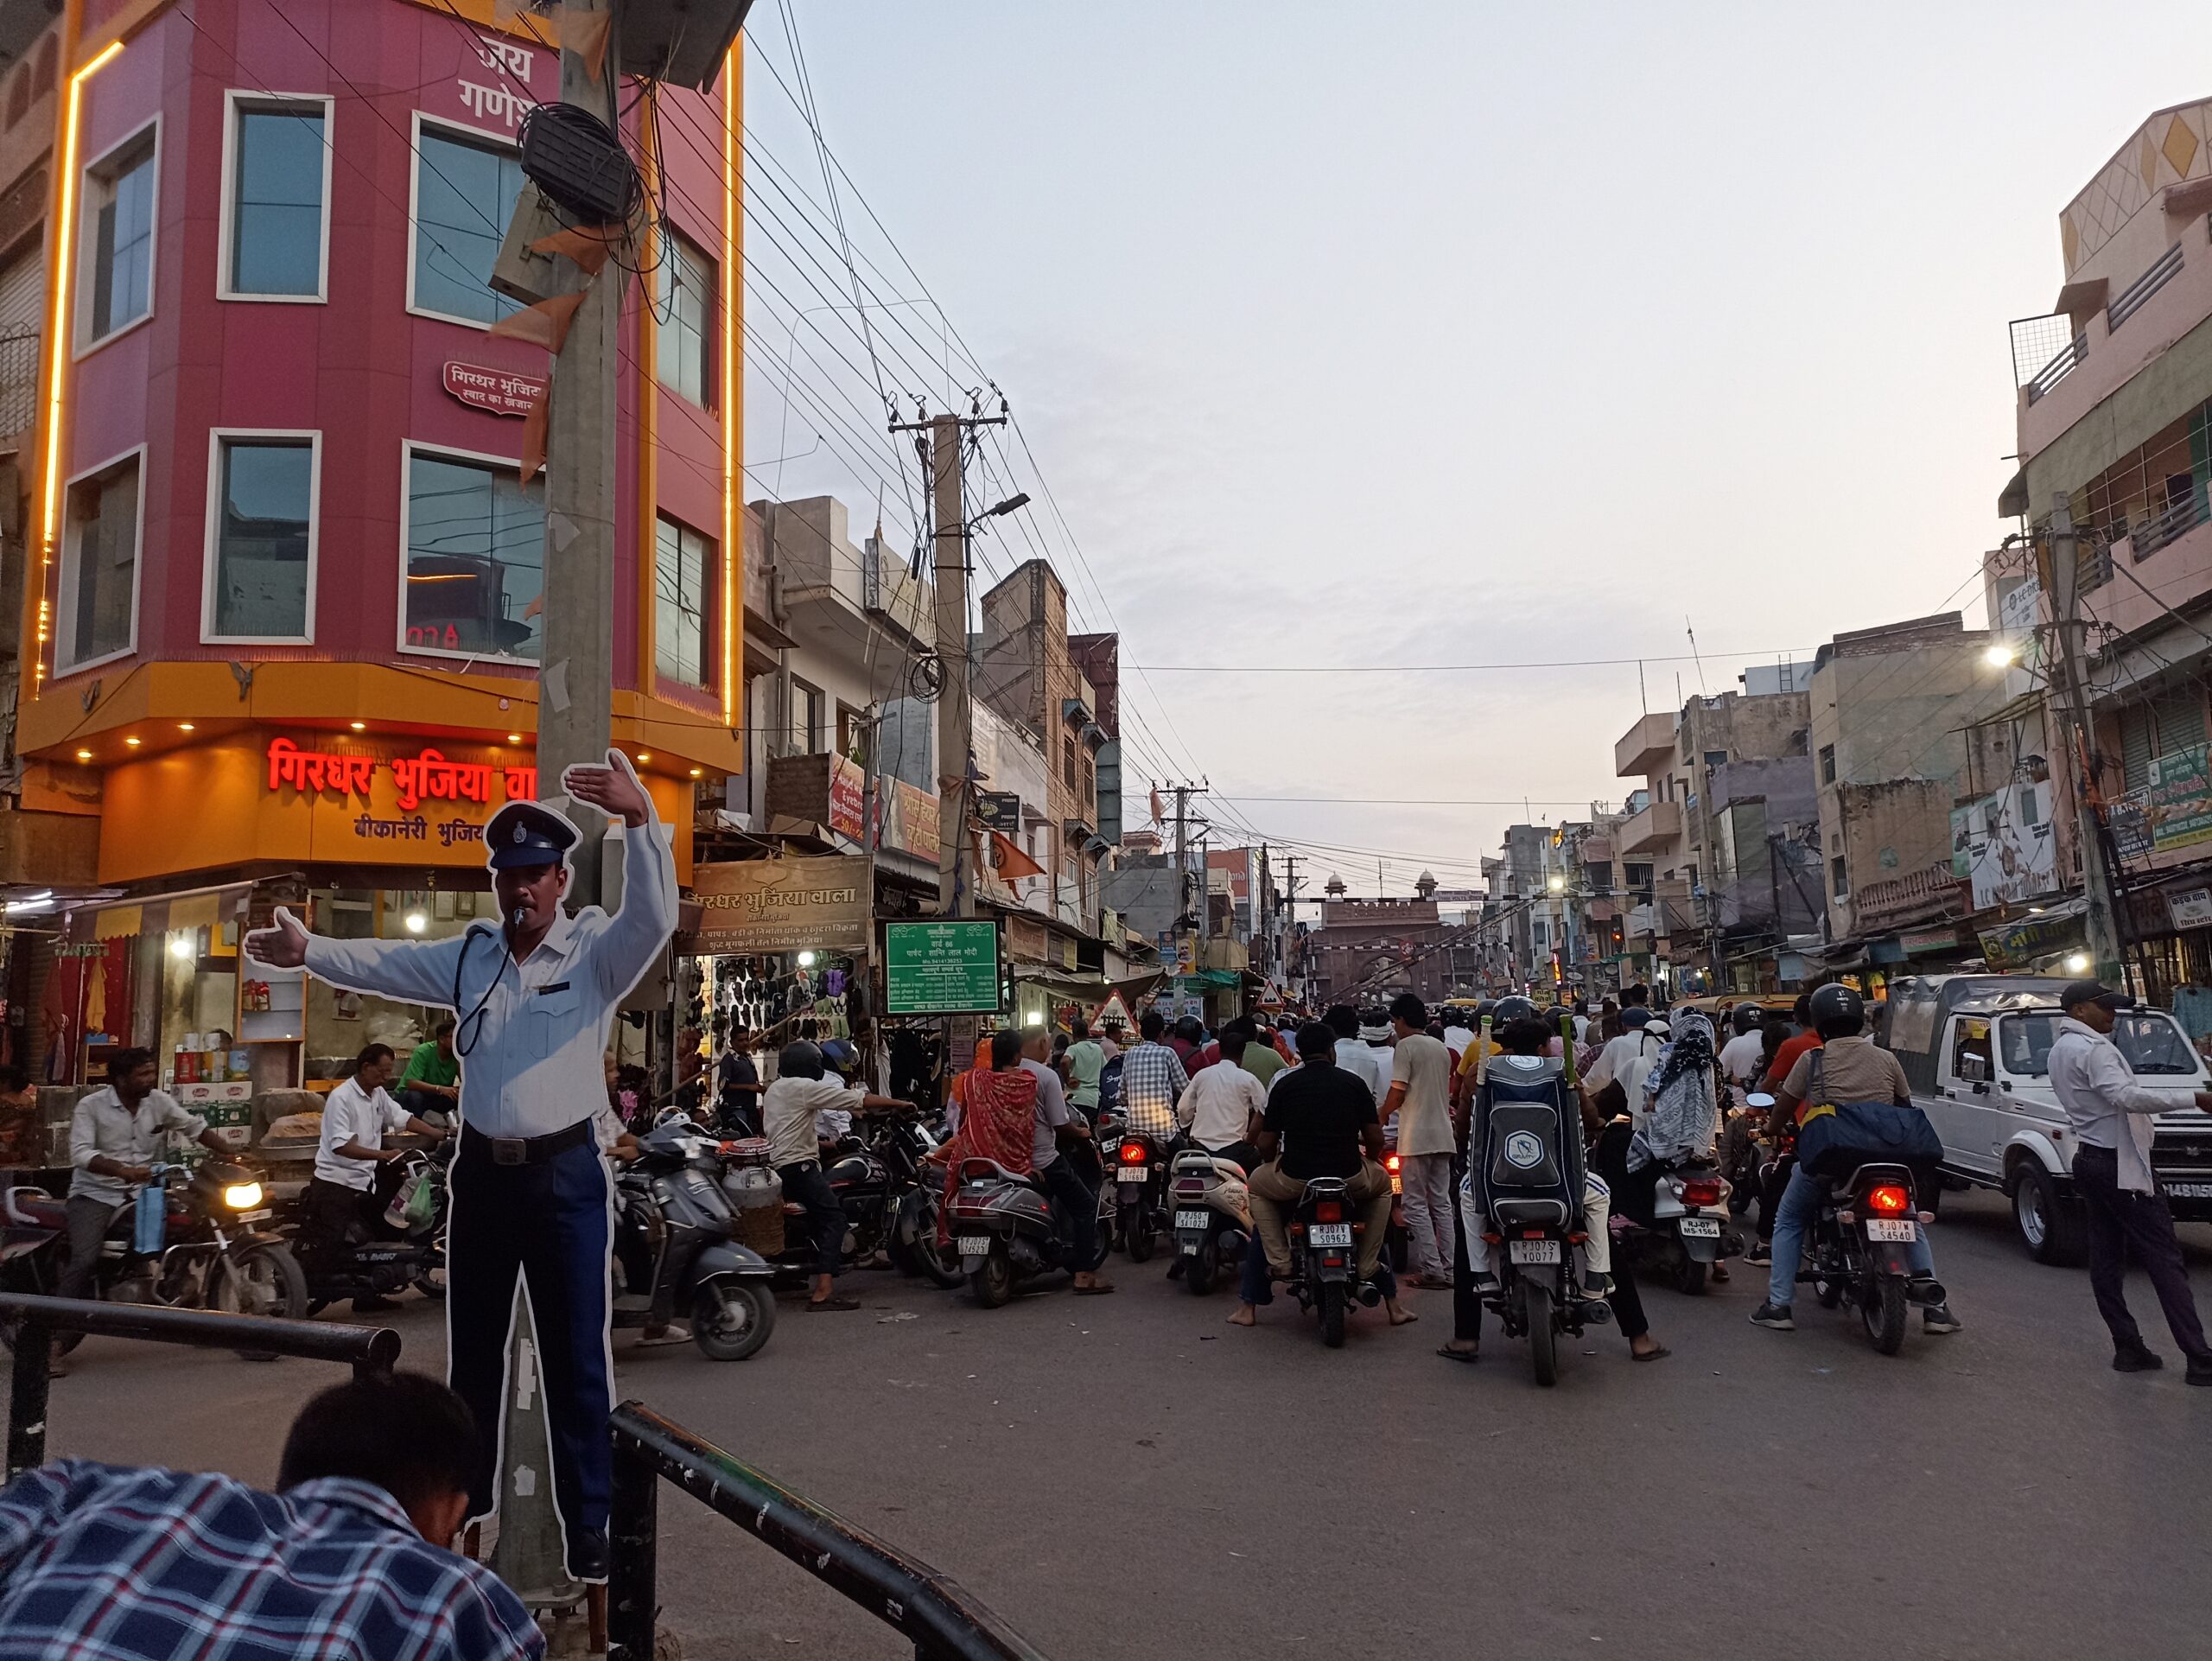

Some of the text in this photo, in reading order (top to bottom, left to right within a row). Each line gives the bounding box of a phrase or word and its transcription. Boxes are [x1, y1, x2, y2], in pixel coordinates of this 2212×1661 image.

[477, 35, 534, 83] जय
[452, 366, 496, 390] गिरधर
[463, 389, 486, 402] स्वाद
[488, 394, 501, 404] का
[268, 737, 372, 794] गिरधर
[392, 748, 493, 810] भुजिया
[353, 814, 485, 847] बीकानेरी भुजिय
[744, 887, 808, 913] भुजिया
[810, 887, 856, 905] वाला
[931, 939, 943, 948] वार्ड
[964, 946, 977, 956] मोदी
